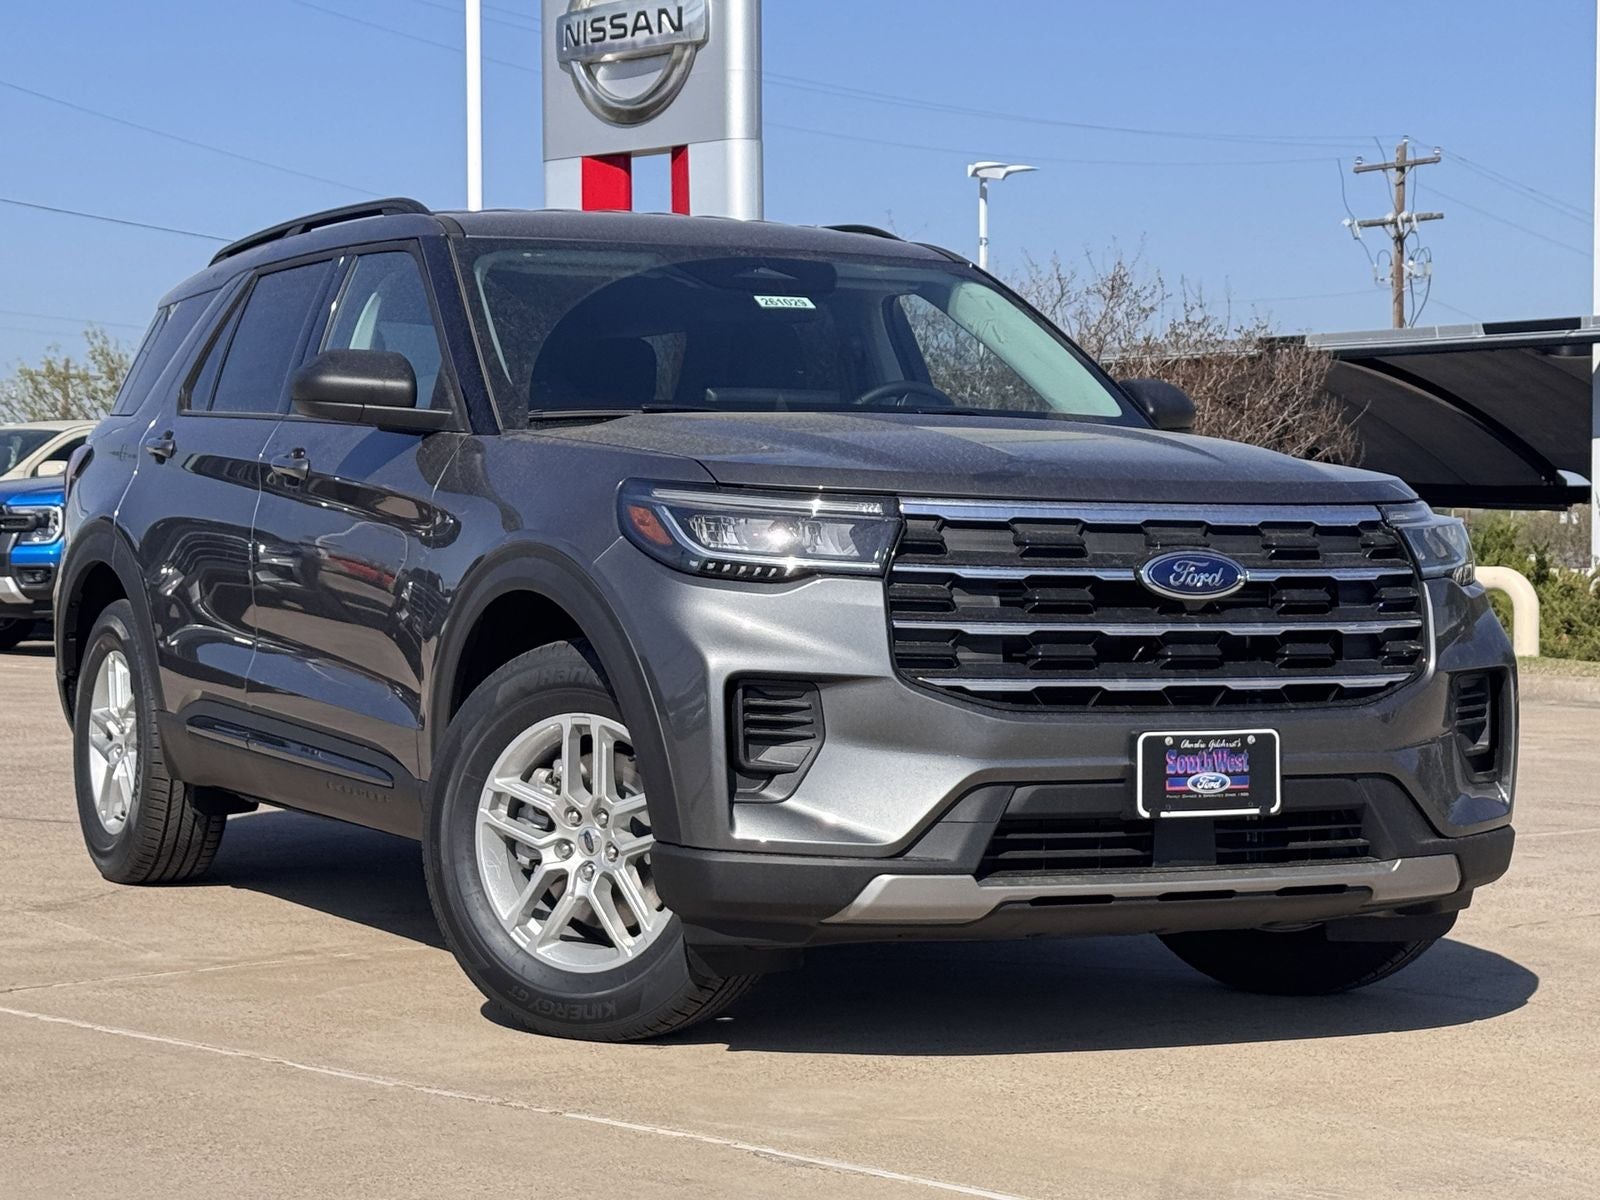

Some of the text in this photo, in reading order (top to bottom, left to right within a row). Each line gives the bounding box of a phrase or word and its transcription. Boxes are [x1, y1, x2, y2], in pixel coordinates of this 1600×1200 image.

[564, 6, 684, 48] NISSAN
[1169, 559, 1225, 588] Ford
[1196, 776, 1222, 790] Ford
[527, 999, 617, 1021] KINERGY
